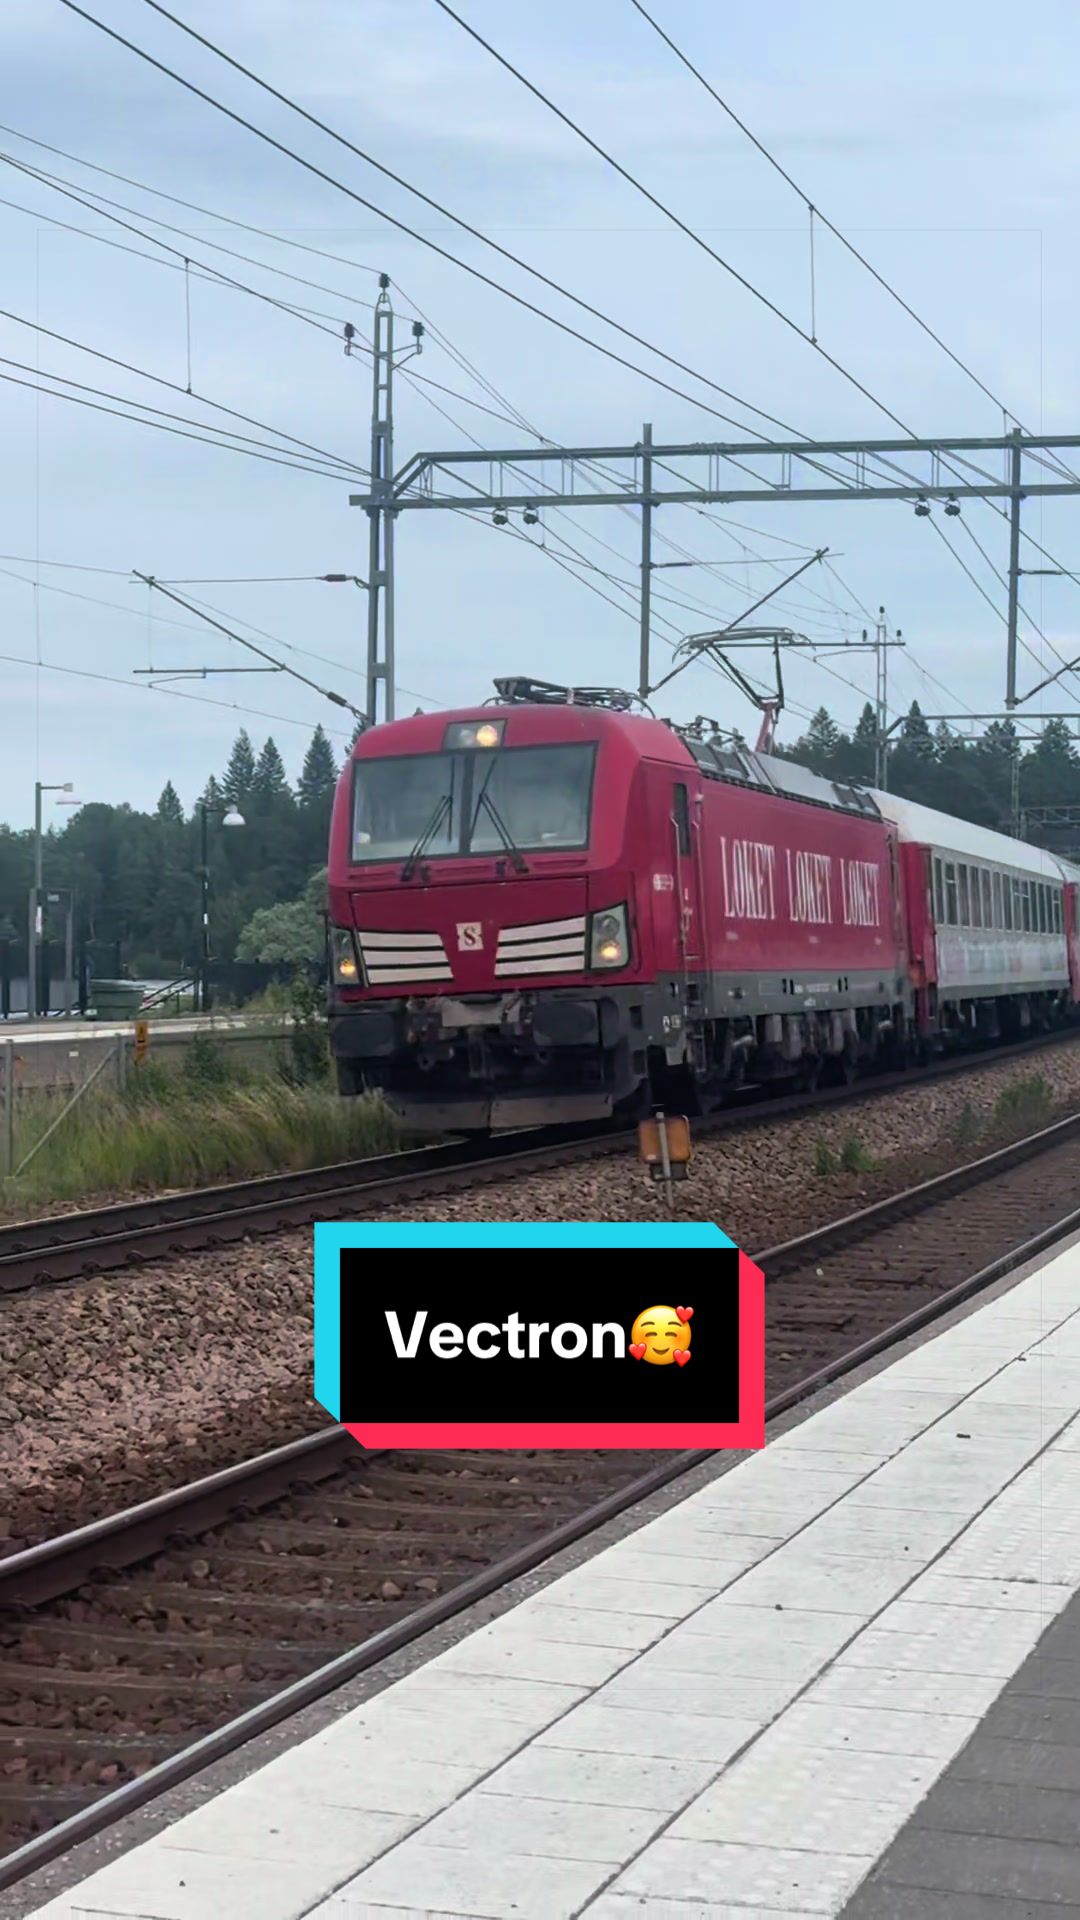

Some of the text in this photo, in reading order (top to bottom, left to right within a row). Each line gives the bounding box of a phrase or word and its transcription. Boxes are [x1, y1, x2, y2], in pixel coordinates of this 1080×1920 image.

[720, 837, 881, 927] LOKET LOKET LOKET
[463, 926, 477, 947] S
